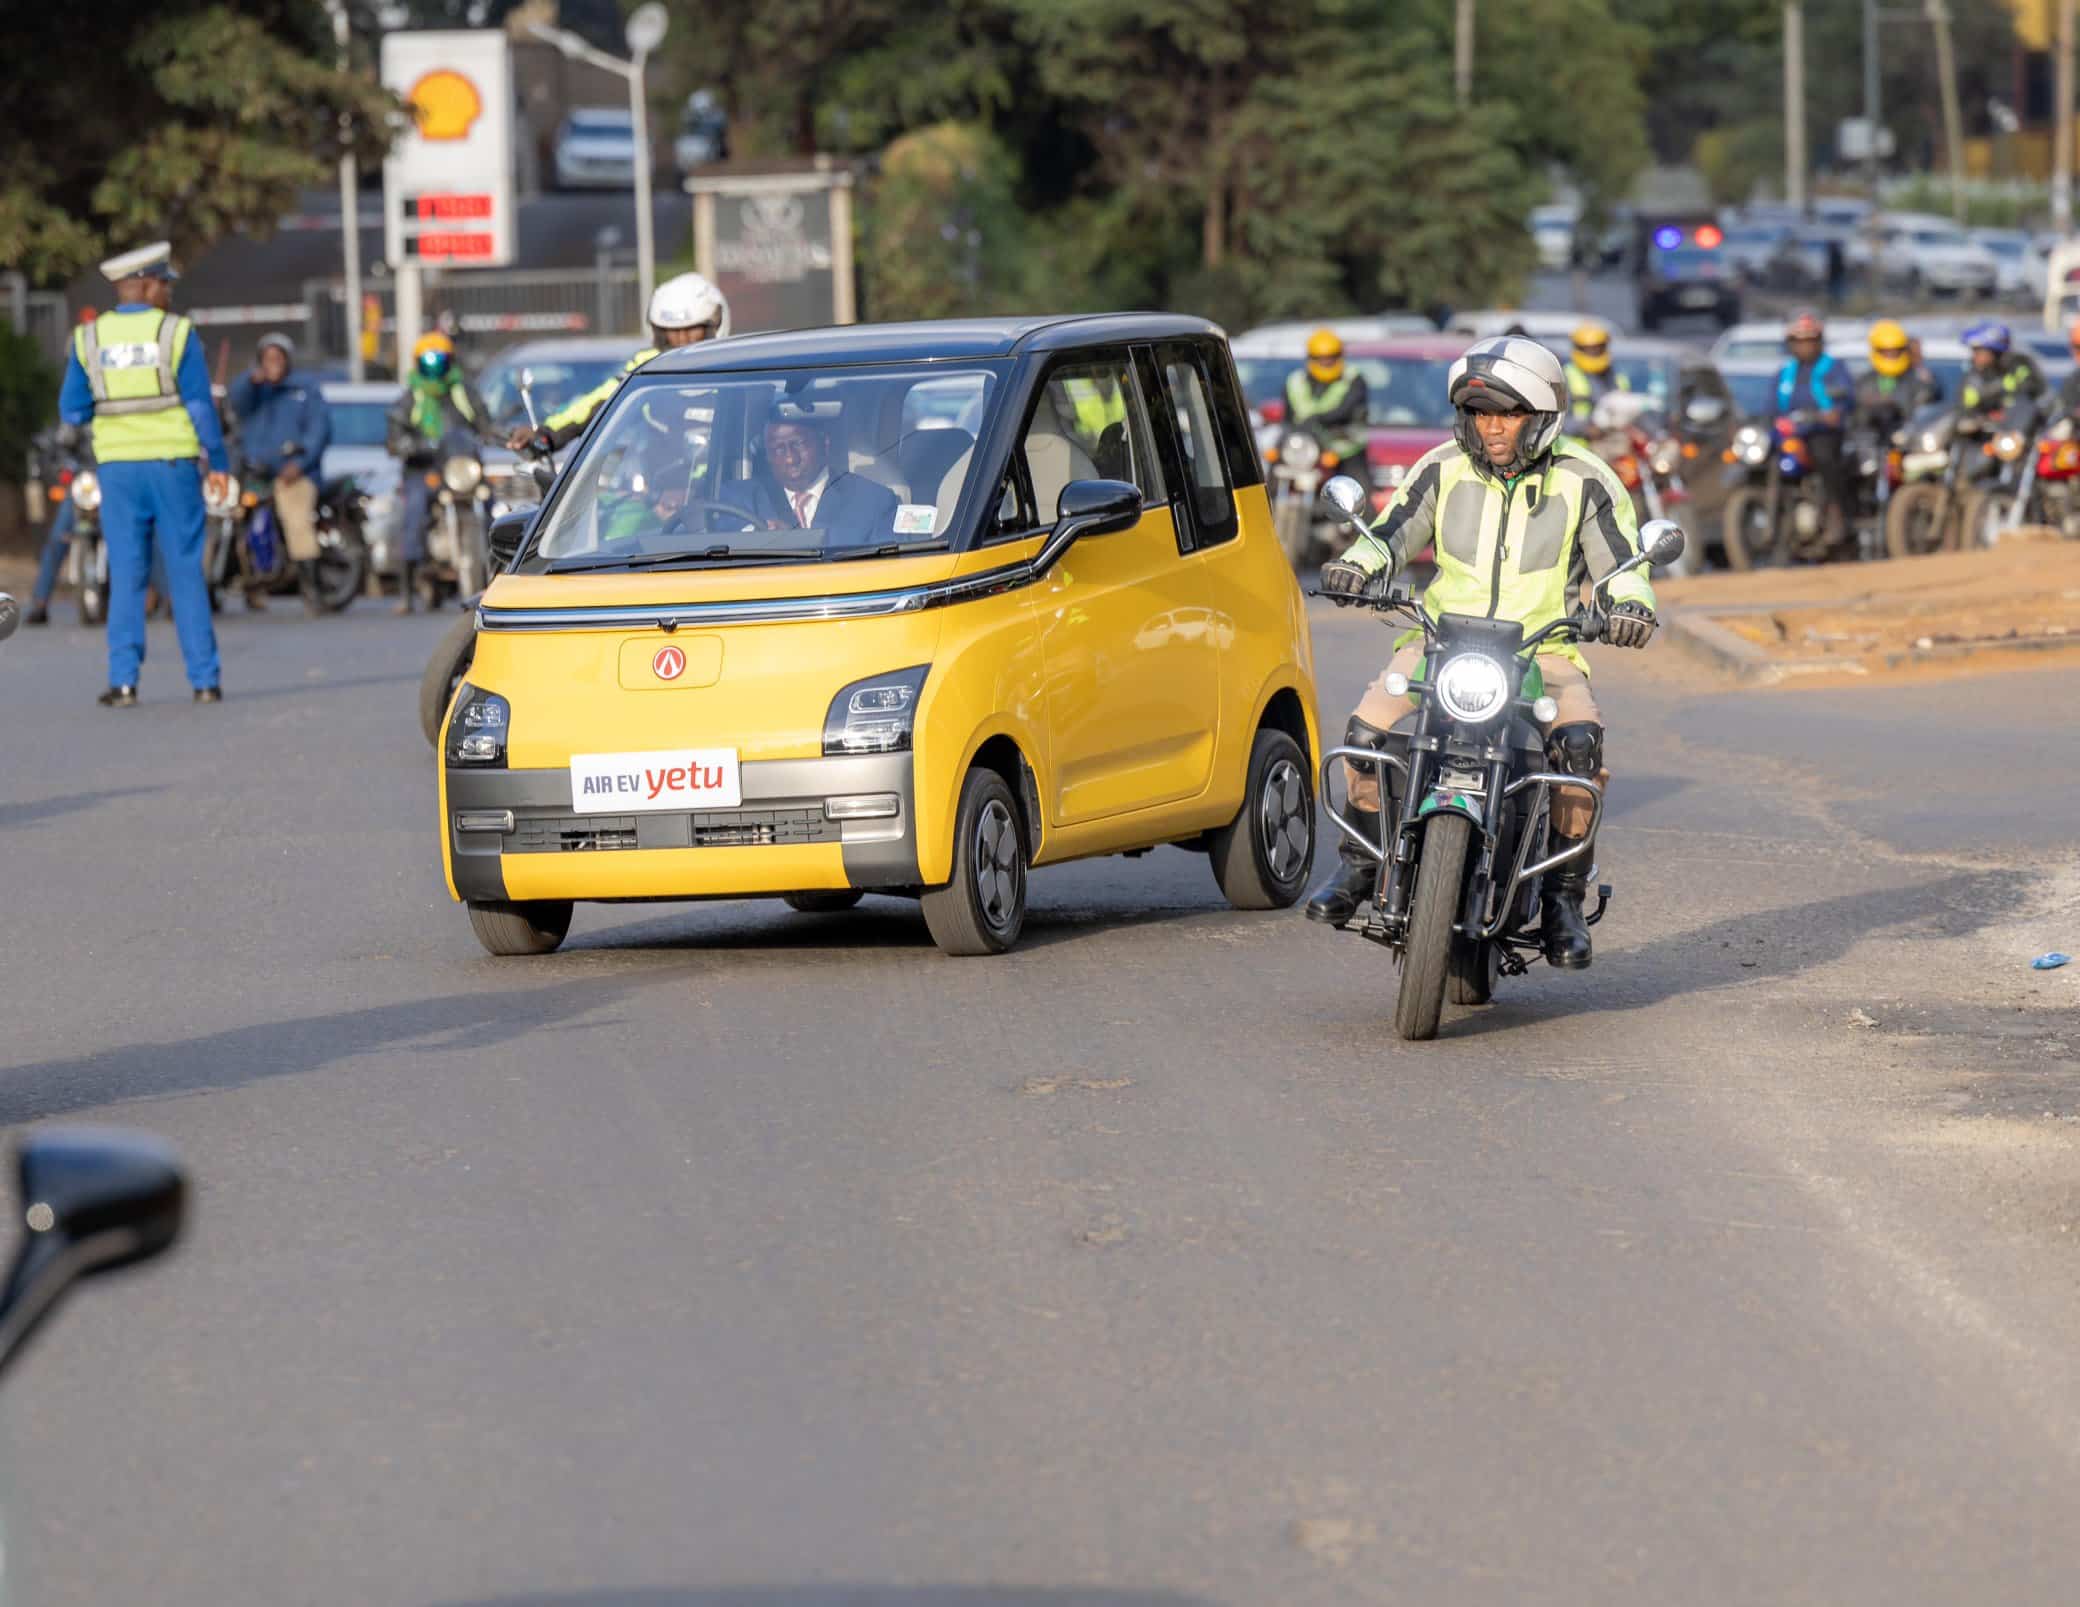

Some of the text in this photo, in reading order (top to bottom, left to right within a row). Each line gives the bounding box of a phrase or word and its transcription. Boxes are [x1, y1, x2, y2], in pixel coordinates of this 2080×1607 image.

[583, 761, 724, 800] AIR EV yetu
